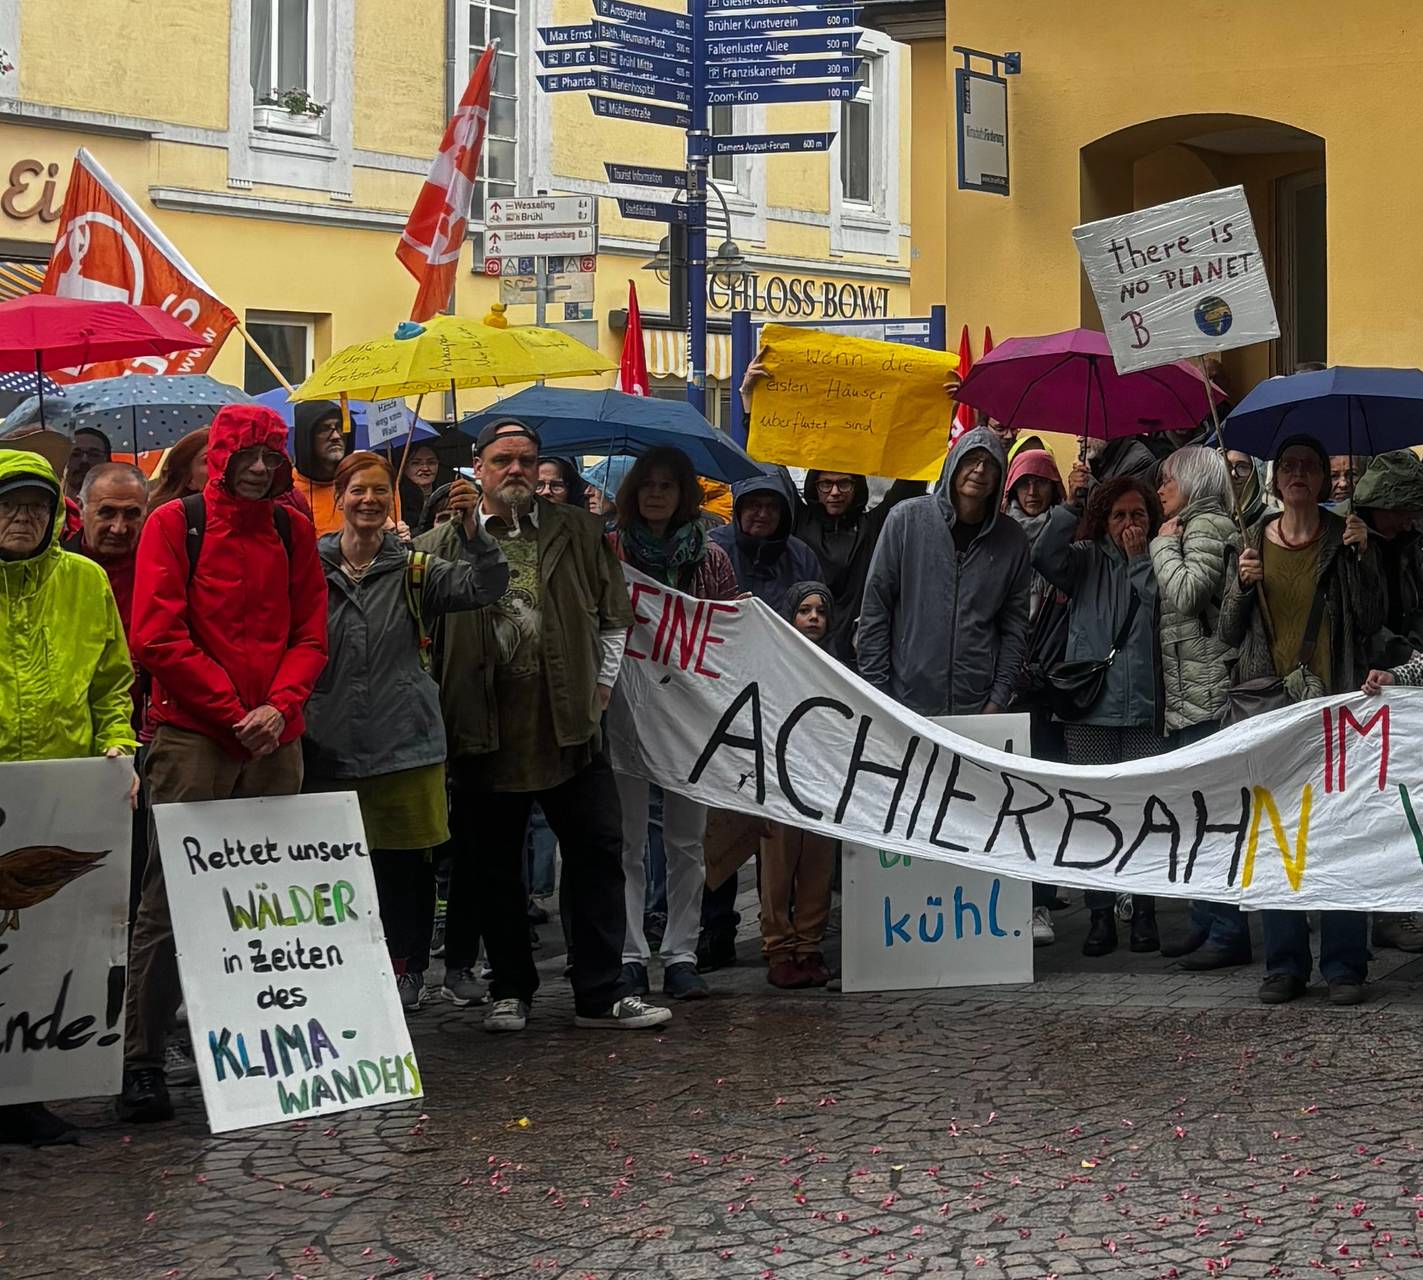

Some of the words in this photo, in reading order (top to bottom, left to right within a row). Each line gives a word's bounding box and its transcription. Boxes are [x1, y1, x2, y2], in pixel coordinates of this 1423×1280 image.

[708, 20, 741, 31] Brühler
[744, 17, 798, 30] Kunstverein
[827, 16, 840, 25] 600
[550, 32, 567, 41] Max
[570, 30, 591, 40] Ernst
[708, 43, 763, 55] Falkenluster
[765, 40, 789, 52] Allee
[827, 40, 840, 48] 500
[619, 55, 635, 68] Brühl
[637, 58, 654, 71] Mitte
[722, 63, 796, 78] Franziskanerhof
[827, 64, 840, 73] 300
[610, 78, 656, 95] Marienhospital
[708, 91, 759, 103] Zoom-Kino
[827, 88, 840, 97] 100
[717, 142, 744, 152] Clemens
[745, 141, 790, 153] August-Forum
[803, 139, 814, 148] 600
[614, 167, 631, 181] Tourist
[632, 169, 663, 184] Information
[514, 201, 556, 210] Wesseling
[521, 212, 543, 221] Brühl
[1108, 235, 1194, 274] there
[1209, 221, 1233, 244] is
[1121, 279, 1150, 303] NO
[1159, 252, 1254, 290] PLANET
[1121, 311, 1150, 349] B
[806, 348, 864, 367] Wenn
[882, 353, 913, 373] die
[766, 378, 809, 394] ersten
[825, 378, 887, 400] Häuser
[843, 418, 874, 434] sind
[624, 581, 740, 680] EINE
[1322, 704, 1390, 793] IM
[183, 835, 282, 876] Rettet
[287, 837, 368, 862] unsere
[222, 879, 359, 932] WÄLDER
[884, 878, 1021, 947] kühl.
[222, 947, 243, 974] in
[248, 937, 344, 973] Zeiten
[0, 964, 122, 1054] nde!
[257, 985, 308, 1010] des
[277, 1051, 423, 1115] WANDELS
